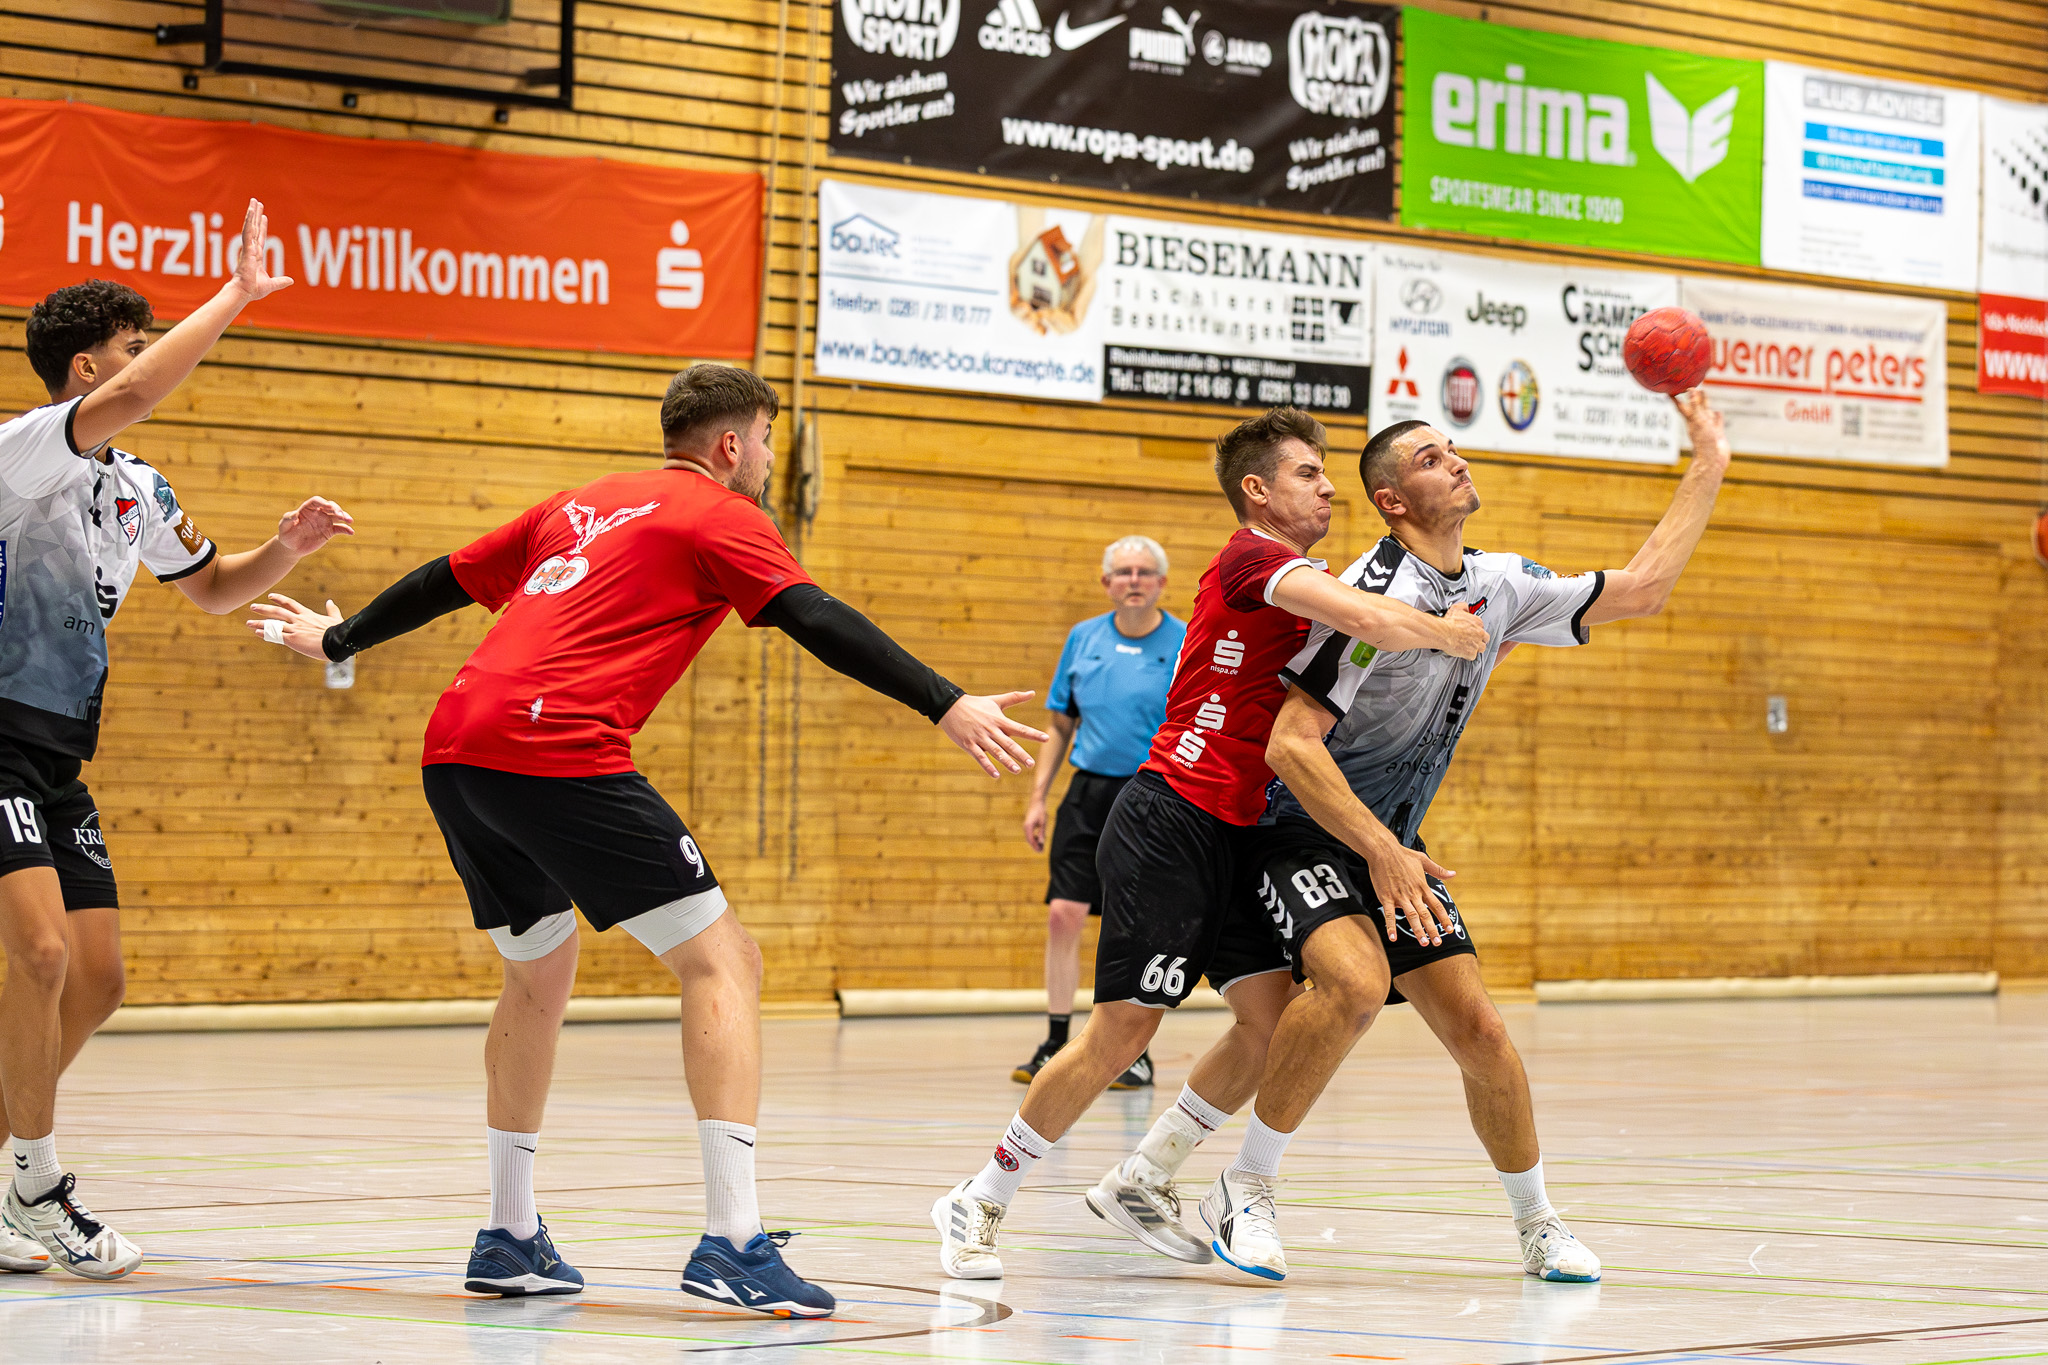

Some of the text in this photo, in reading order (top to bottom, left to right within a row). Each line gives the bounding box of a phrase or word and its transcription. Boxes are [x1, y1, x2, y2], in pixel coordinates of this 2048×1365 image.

[862, 17, 939, 61] SPORT
[978, 25, 1051, 58] adidas
[1129, 27, 1187, 66] PUMA
[1226, 37, 1272, 68] JAKO
[842, 70, 948, 105] Wir ziehen
[1307, 81, 1373, 118] SPORT
[1805, 80, 1942, 124] PLUS ADVISE
[839, 101, 922, 137] Sportler
[1432, 63, 1629, 166] erima
[1001, 117, 1254, 173] www.ropa-sport.de
[1288, 126, 1380, 163] Wir ziehen
[1286, 157, 1355, 192] Sportler
[1430, 175, 1623, 225] SPORTSWEAR SINCE 1900
[830, 226, 901, 258] bautec
[1115, 231, 1364, 288] BIESEMANN
[297, 223, 610, 305] Willkommen
[829, 289, 881, 315] Telefon
[1467, 292, 1528, 333] Jeep
[1562, 284, 1649, 330] CRAME
[1112, 306, 1286, 342] Bestattungen
[821, 339, 1096, 385] www.bautec-baukonzepte.de
[1578, 331, 1626, 372] SCH
[1826, 342, 1926, 394] peters
[1110, 367, 1143, 393] Tel.:
[63, 615, 96, 635] am
[1210, 664, 1239, 675] nispa.de
[1169, 753, 1194, 769] nispa.de
[0, 796, 42, 844] 19
[679, 834, 706, 878] 9
[1291, 863, 1350, 909] 83
[1140, 953, 1188, 997] 66
